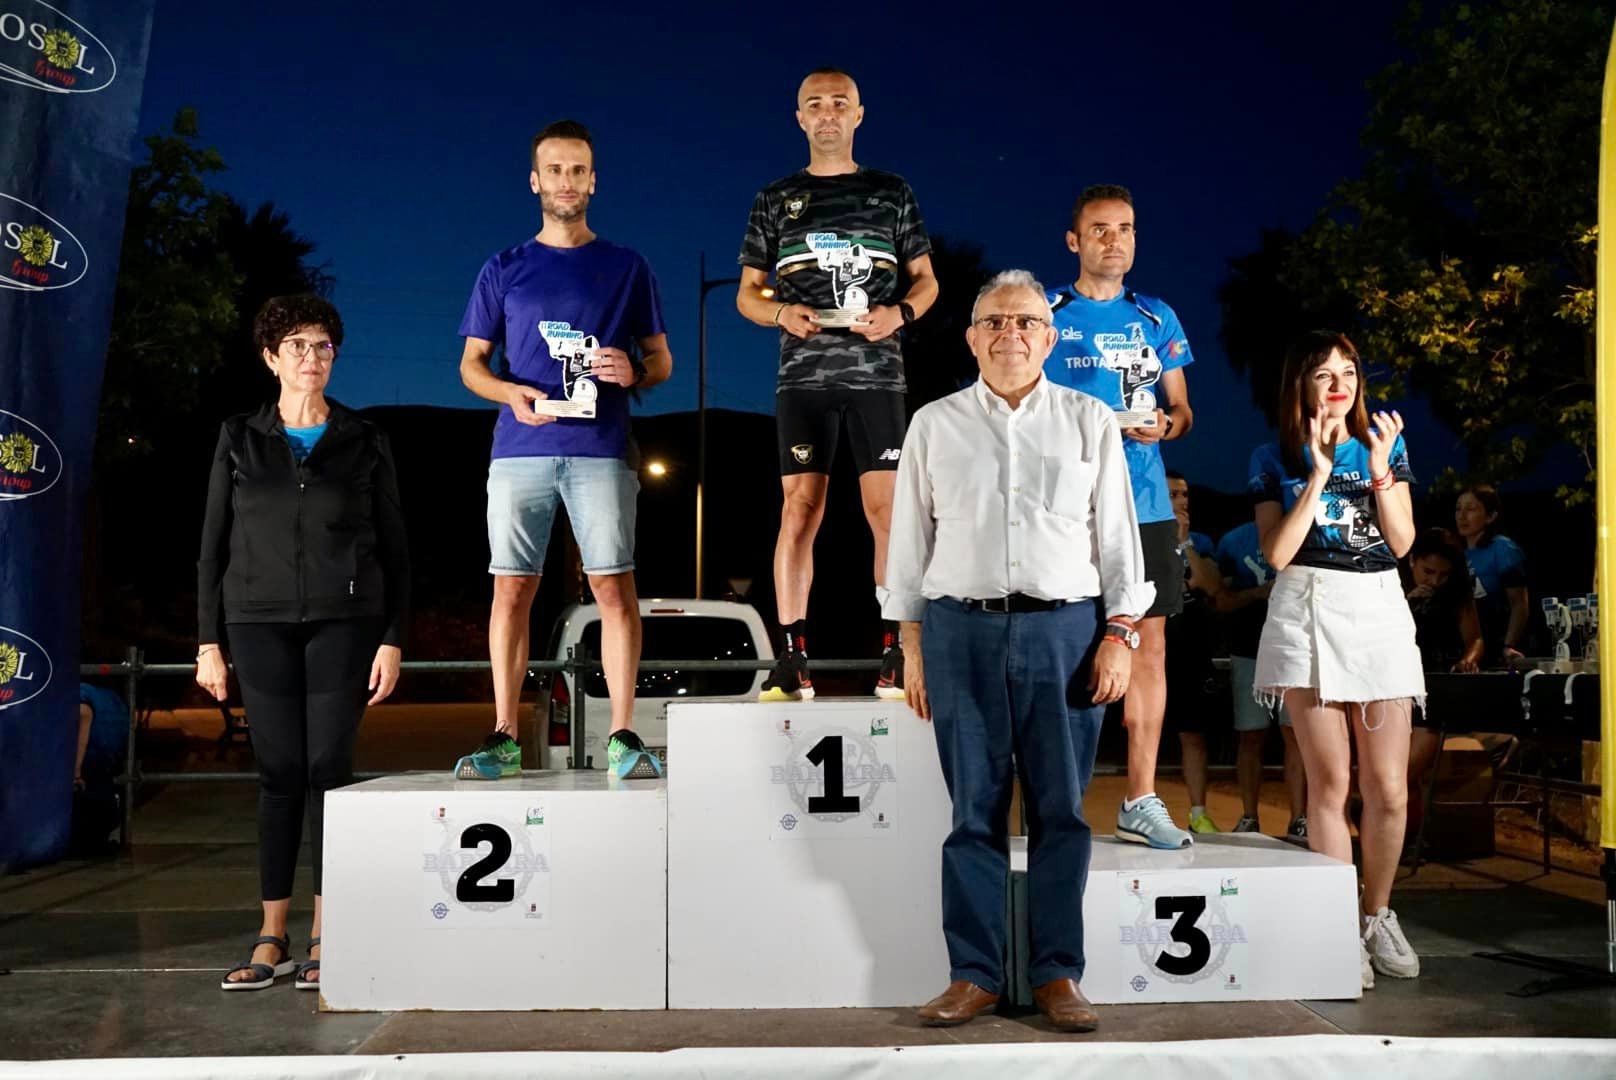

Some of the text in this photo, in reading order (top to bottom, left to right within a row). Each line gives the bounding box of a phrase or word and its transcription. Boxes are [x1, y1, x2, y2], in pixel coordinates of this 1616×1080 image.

[547, 321, 569, 331] ROAD
[805, 735, 861, 813] 1
[456, 822, 515, 903] 2
[1154, 895, 1212, 976] 3
